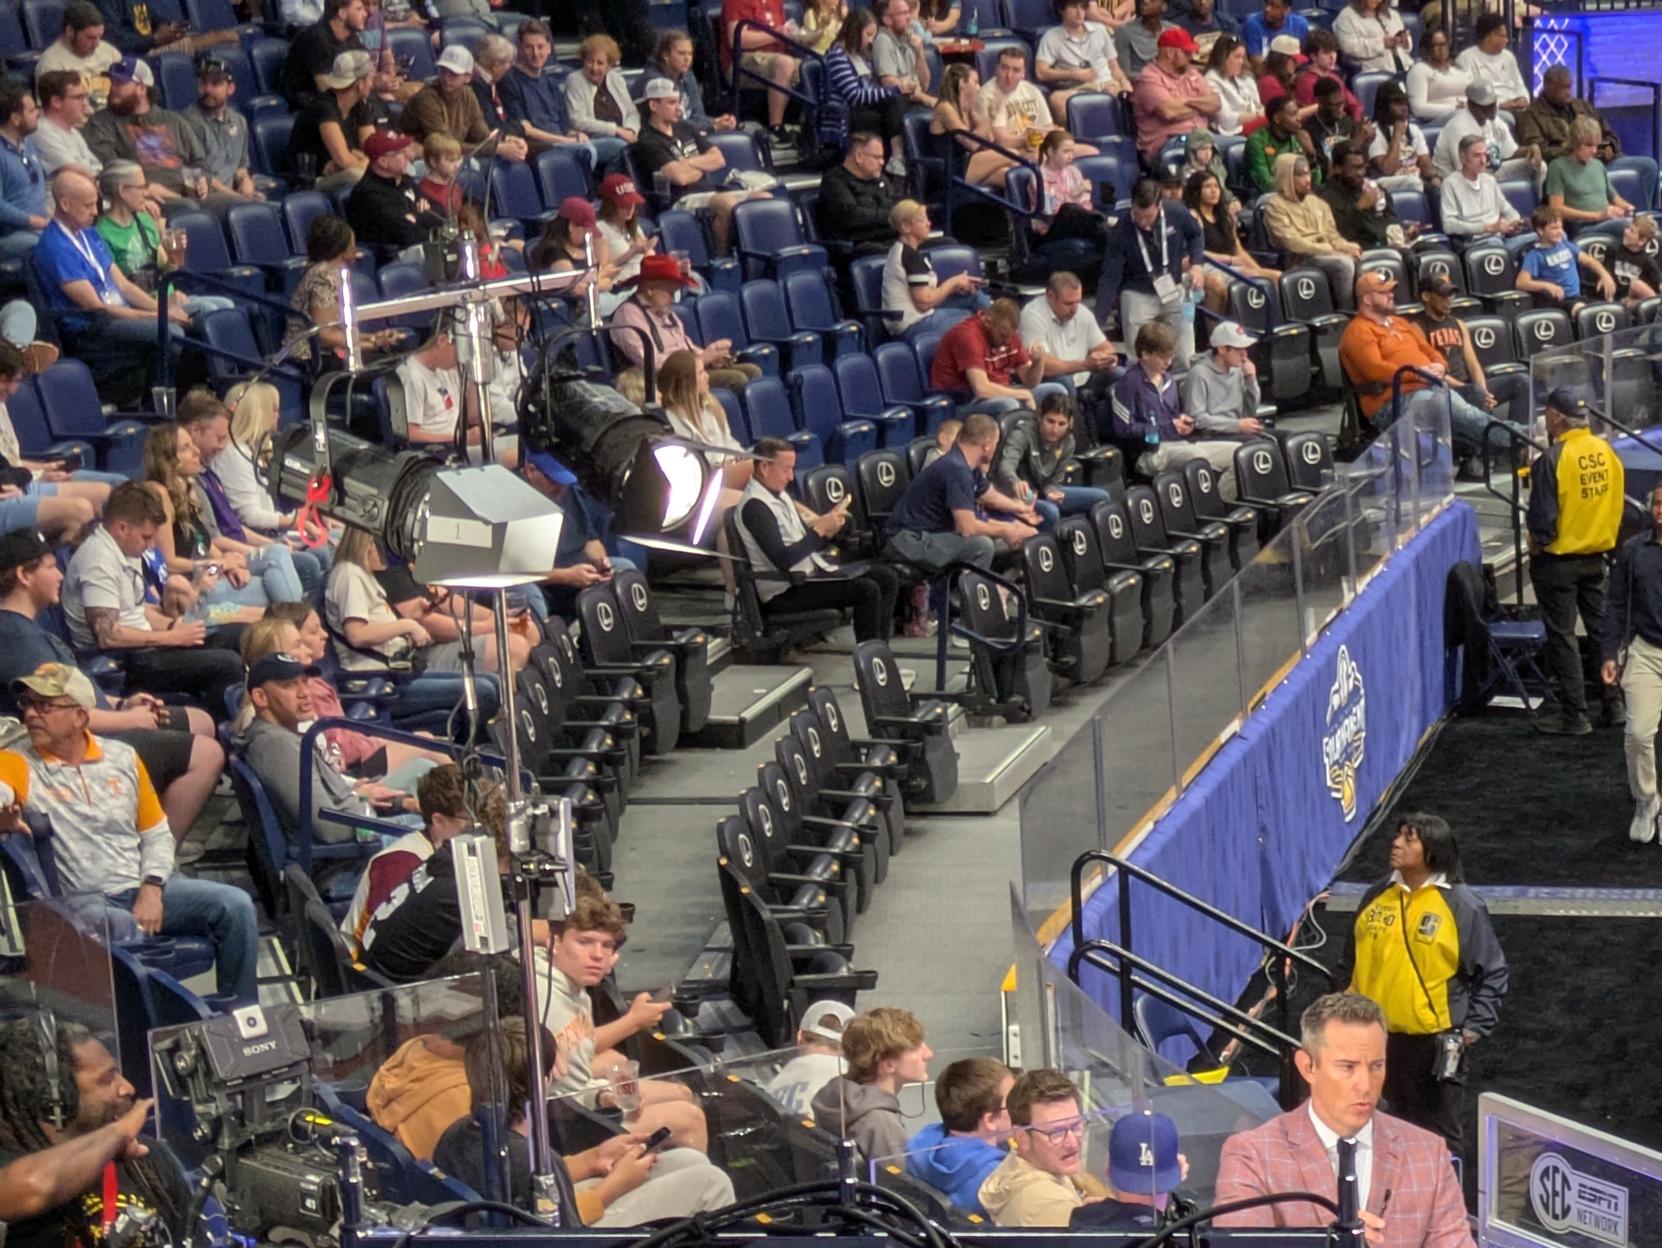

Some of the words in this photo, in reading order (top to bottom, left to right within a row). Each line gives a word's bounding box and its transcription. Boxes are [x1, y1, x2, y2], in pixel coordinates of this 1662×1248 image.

[1428, 327, 1464, 346] TEXAS
[1577, 452, 1606, 470] CSC
[1579, 469, 1609, 486] EVENT
[1580, 483, 1611, 499] STAFF
[242, 1039, 277, 1057] SONY
[1539, 1164, 1572, 1222] SEC
[1577, 1182, 1619, 1213] ESPN
[1576, 1207, 1619, 1238] NETWORK
